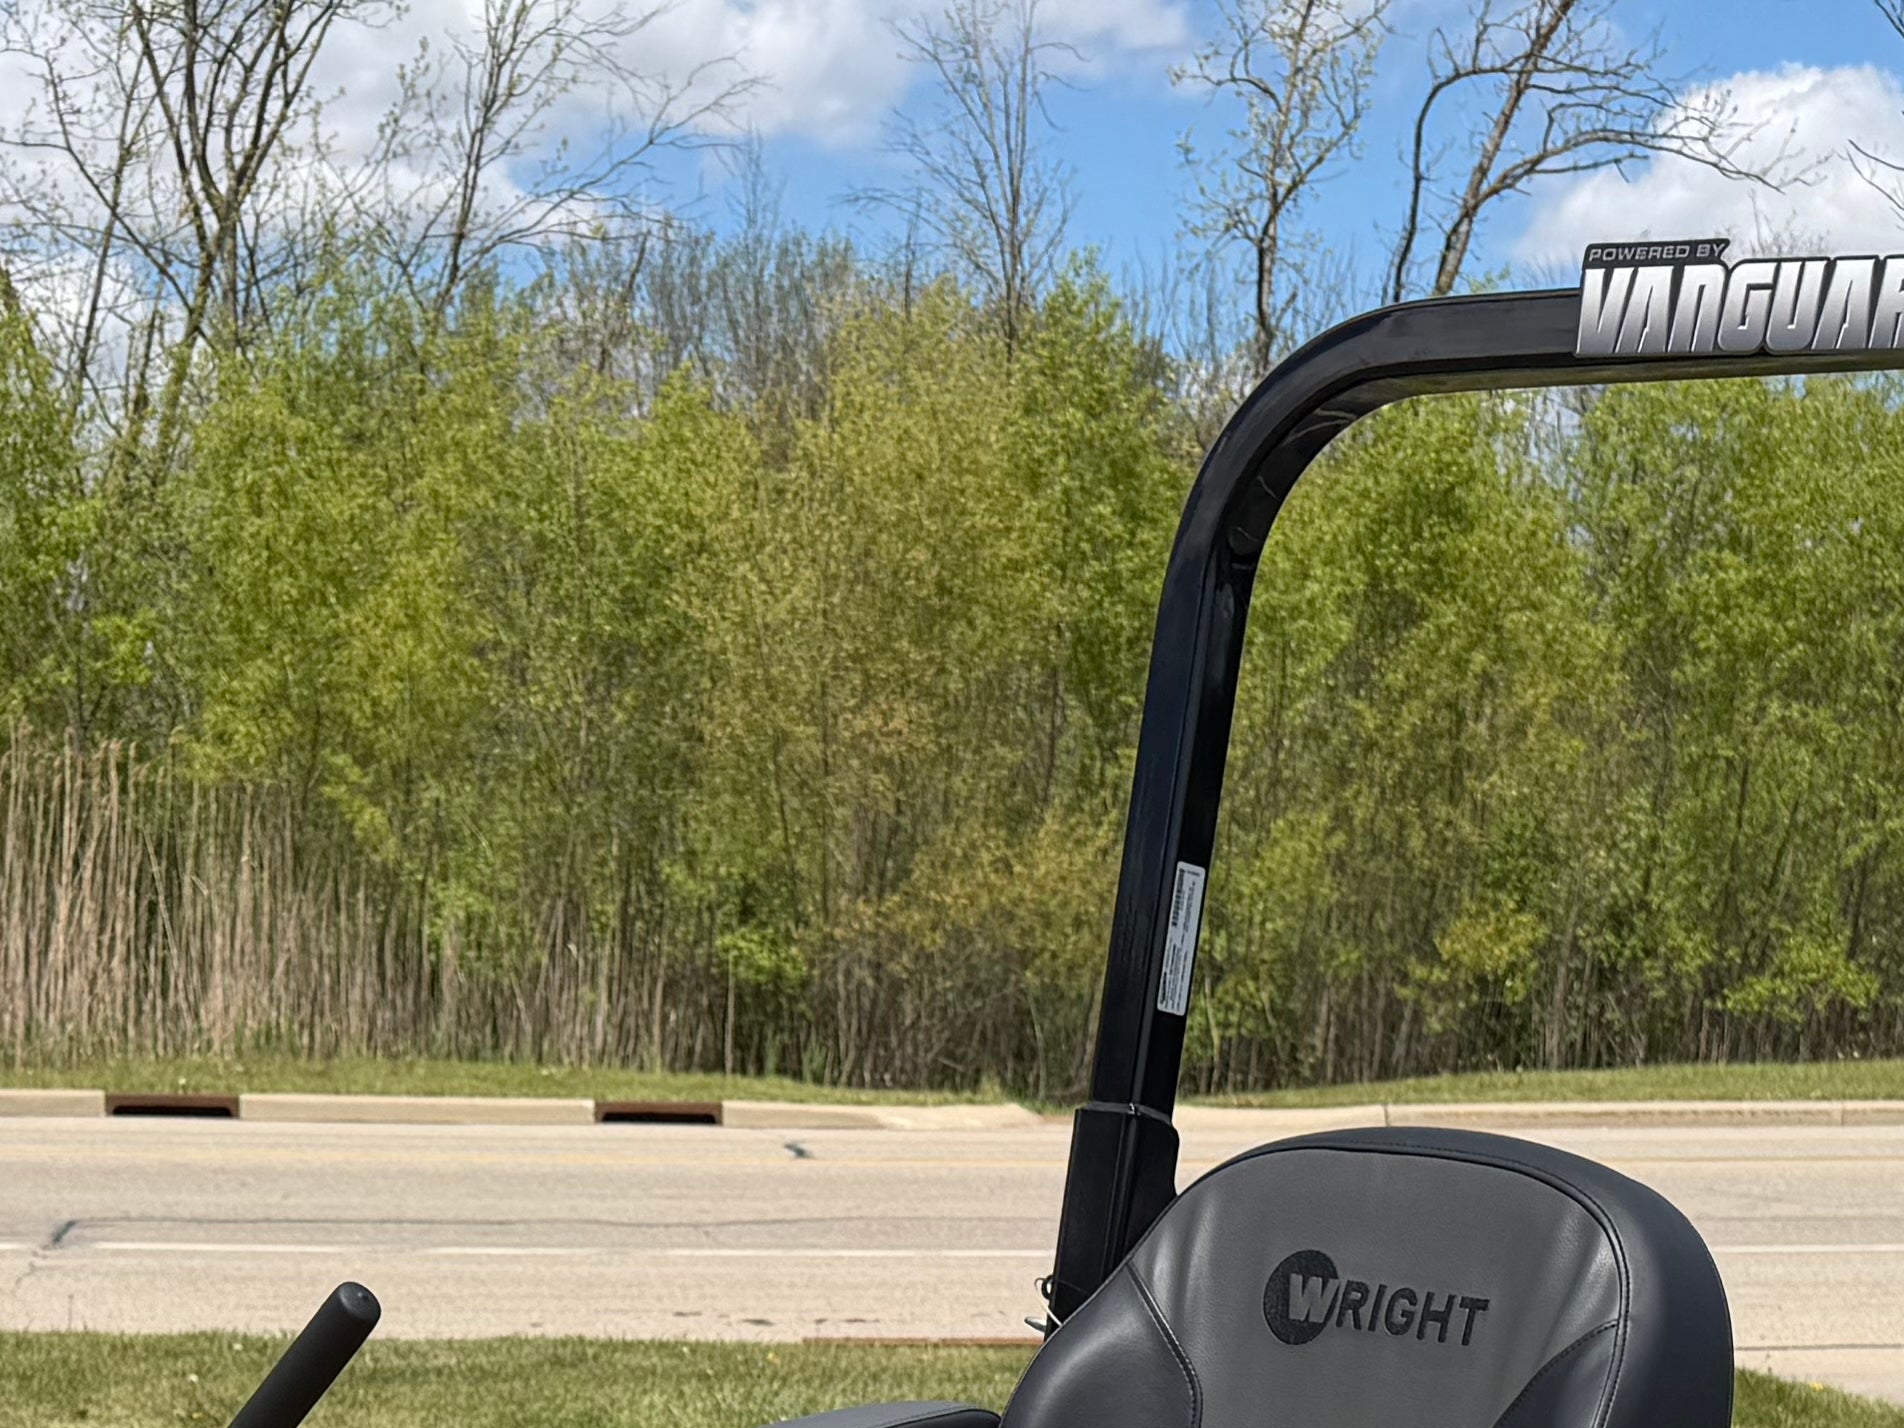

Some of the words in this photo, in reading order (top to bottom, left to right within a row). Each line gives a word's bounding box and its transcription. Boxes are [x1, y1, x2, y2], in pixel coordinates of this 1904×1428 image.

[1588, 245, 1690, 262] POWERED
[1696, 243, 1726, 258] BY
[1286, 1270, 1491, 1347] WRIGHT
